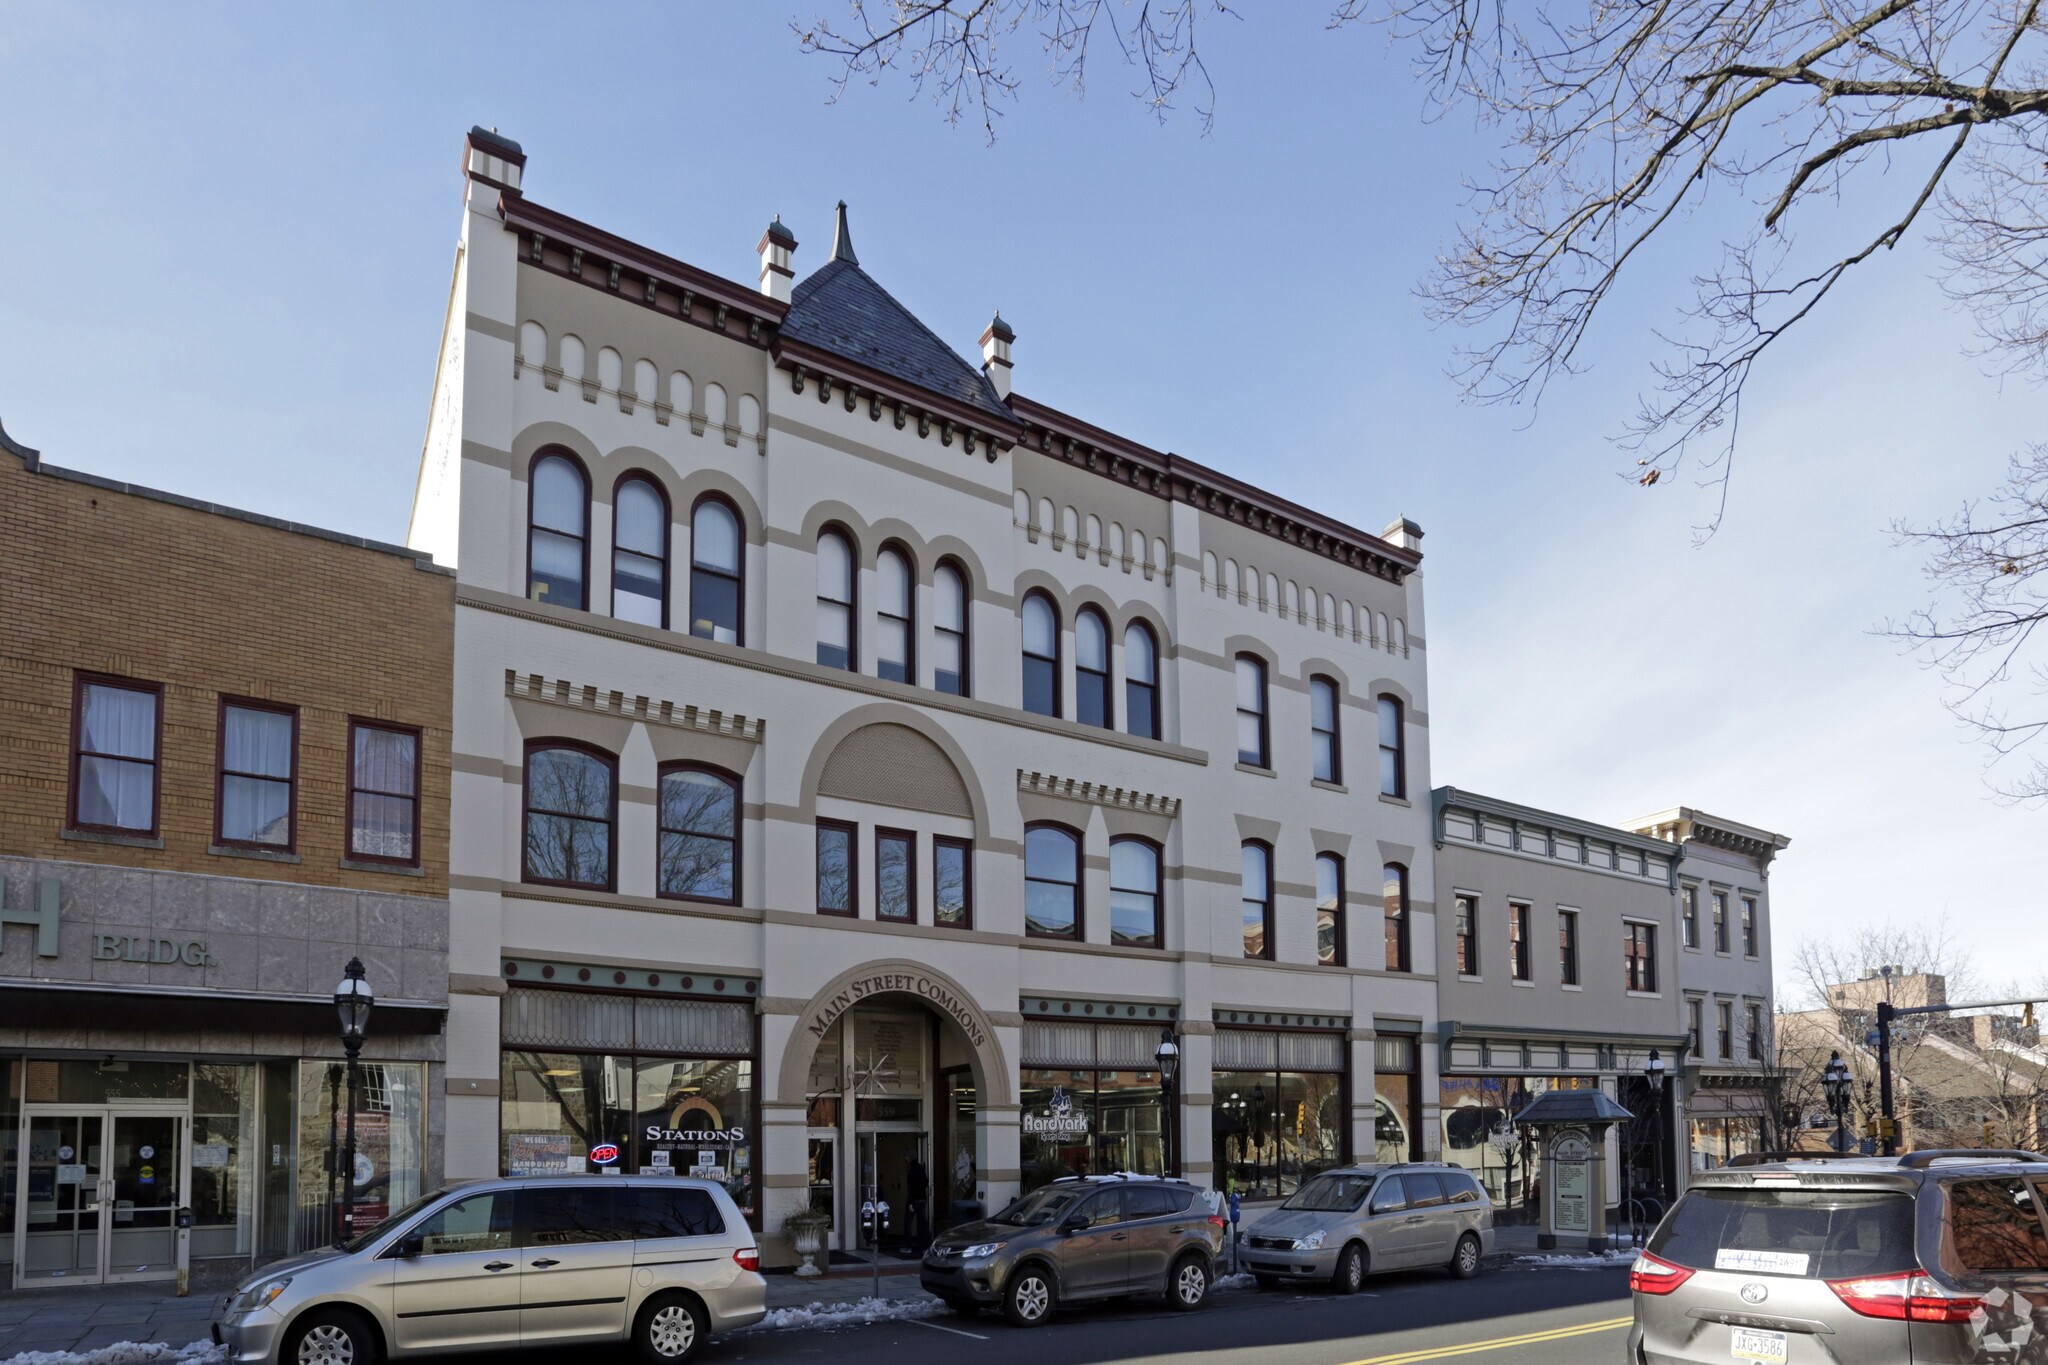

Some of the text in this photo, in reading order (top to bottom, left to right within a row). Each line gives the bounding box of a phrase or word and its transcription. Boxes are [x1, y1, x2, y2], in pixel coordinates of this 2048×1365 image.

[809, 974, 986, 1047] MAIN STREET COMMONS
[104, 1089, 121, 1098] 555
[879, 1107, 895, 1117] 559
[1023, 1113, 1088, 1132] Aardvark
[524, 1136, 548, 1144] WE SELL
[646, 1125, 745, 1141] STATIONS
[590, 1146, 618, 1161] OPEN
